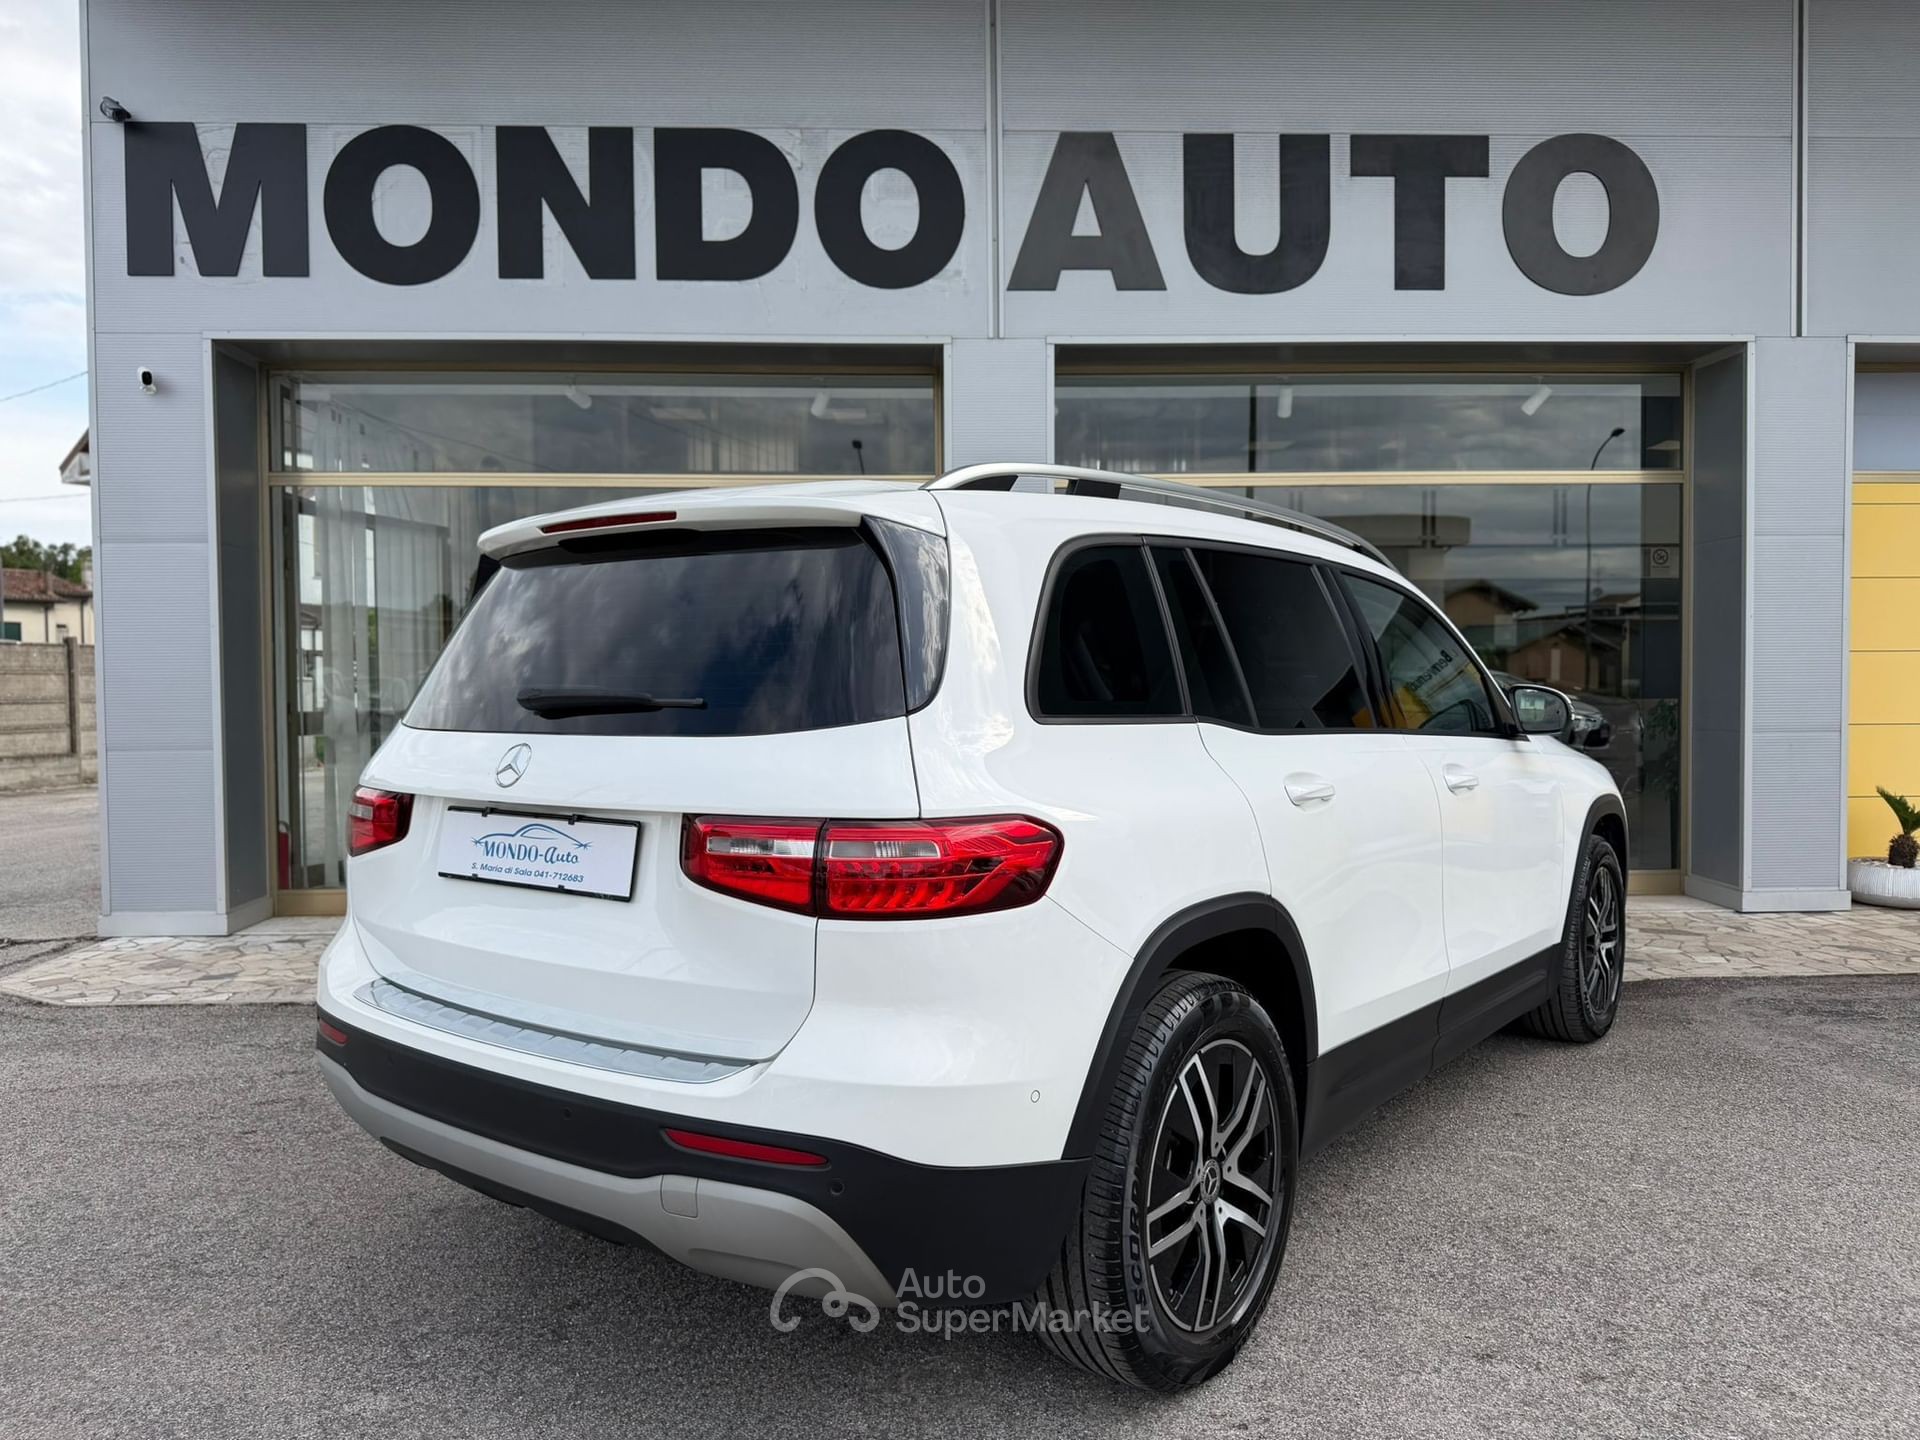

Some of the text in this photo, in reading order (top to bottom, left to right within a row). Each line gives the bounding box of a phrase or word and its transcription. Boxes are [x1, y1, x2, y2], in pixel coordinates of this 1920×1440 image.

[124, 121, 1660, 296] MONDO AUTO
[482, 840, 579, 864] MONDO-Auto
[471, 862, 584, 883] S. Maria di Sala 041-712683
